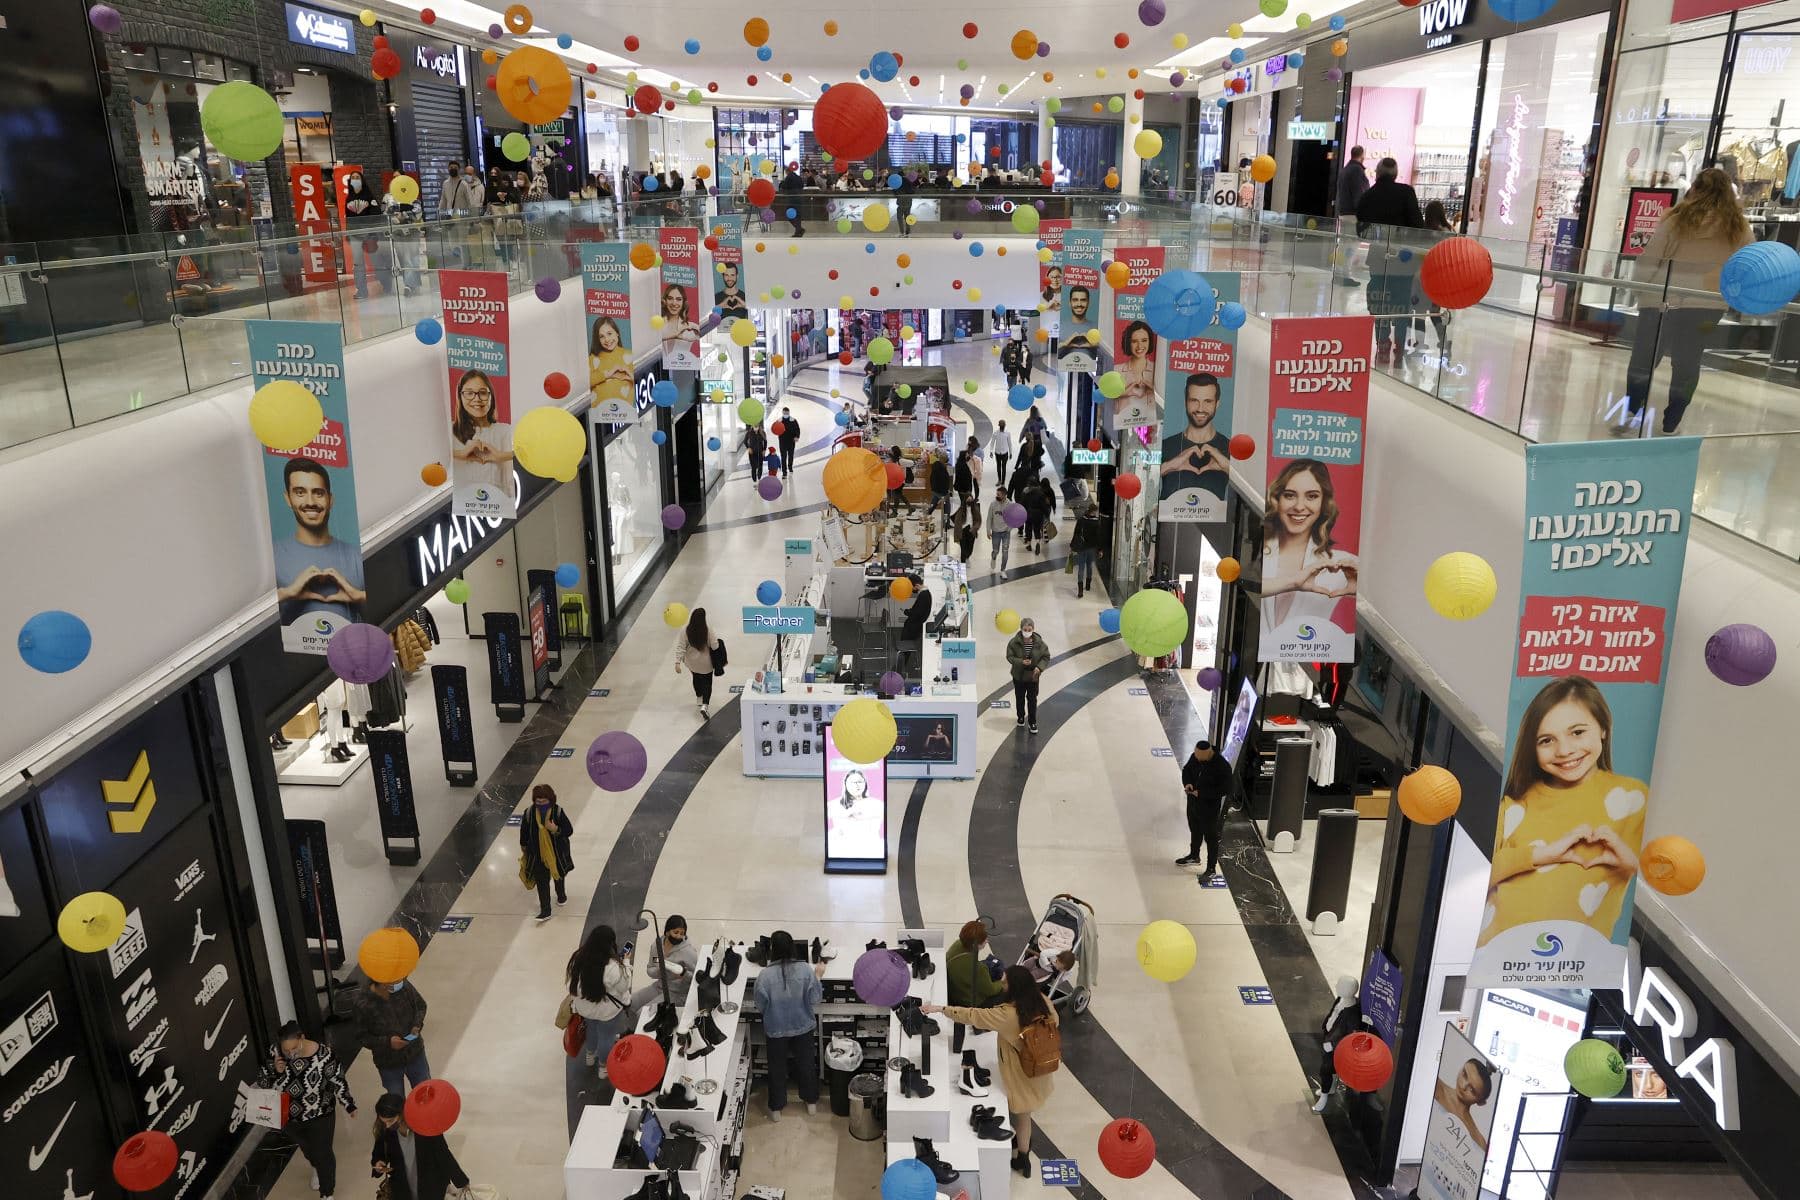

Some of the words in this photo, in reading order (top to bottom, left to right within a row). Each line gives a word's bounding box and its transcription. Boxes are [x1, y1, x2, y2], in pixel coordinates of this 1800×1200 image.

[1420, 0, 1468, 35] WOW
[1427, 34, 1452, 48] LONDON
[147, 179, 200, 196] SMARTER
[1214, 189, 1236, 206] 60
[1637, 199, 1663, 217] 70%
[595, 254, 616, 263] כמה
[1129, 258, 1150, 267] כמה
[583, 264, 629, 272] התגעגענו
[591, 272, 623, 282] אליכם!
[459, 286, 487, 298] כמה
[442, 299, 505, 311] התגעגענו
[453, 311, 496, 324] אליכם!
[457, 338, 472, 347] כיף
[474, 339, 494, 349] איזה
[1183, 340, 1198, 349] כיף
[1200, 341, 1222, 350] איזה
[1301, 339, 1343, 355] כמה
[277, 343, 316, 358] כמה
[447, 348, 478, 357] ולראות
[480, 351, 504, 361] לחזור
[1171, 350, 1203, 360] ולראות
[450, 357, 472, 368] שוב!
[1206, 353, 1230, 362] לחזור
[255, 360, 340, 378] התגעגענו
[474, 361, 500, 371] אתכם
[1174, 360, 1196, 370] שוב!
[1197, 363, 1225, 373] אתכם
[1275, 358, 1367, 375] התגעגענו
[1290, 374, 1352, 393] אליכם!
[1292, 414, 1313, 427] כיף
[1316, 416, 1347, 427] איזה
[1275, 428, 1320, 441] ולראות
[1324, 430, 1358, 443] לחזור
[302, 446, 337, 460] אתכם
[1280, 443, 1309, 456] שוב!
[1313, 446, 1352, 458] אתכם
[1574, 479, 1642, 507] כמה
[1528, 508, 1681, 541] התגעגענו
[1551, 538, 1652, 571] אליכם!
[755, 607, 804, 626] Partner
[1552, 604, 1582, 625] כיף
[1589, 604, 1639, 623] איזה
[1522, 625, 1593, 648] ולראות
[1600, 627, 1656, 648] לחזור
[1280, 643, 1297, 651] ימים
[1299, 643, 1312, 652] עיר
[1313, 643, 1331, 653] קניון
[1528, 653, 1573, 672] שוב!
[1579, 655, 1642, 673] אתכם
[174, 859, 201, 890] VANS
[114, 936, 145, 975] REEF
[1503, 960, 1531, 972] ימים
[1535, 960, 1556, 972] עיר
[1557, 959, 1585, 973] קניון
[1502, 974, 1524, 982] שלכם
[1526, 974, 1546, 982] טובים
[1562, 973, 1584, 982] הימים
[1492, 995, 1531, 1014] SACARA
[3, 1060, 60, 1123] saucony
[1446, 1117, 1471, 1157] 24/7
